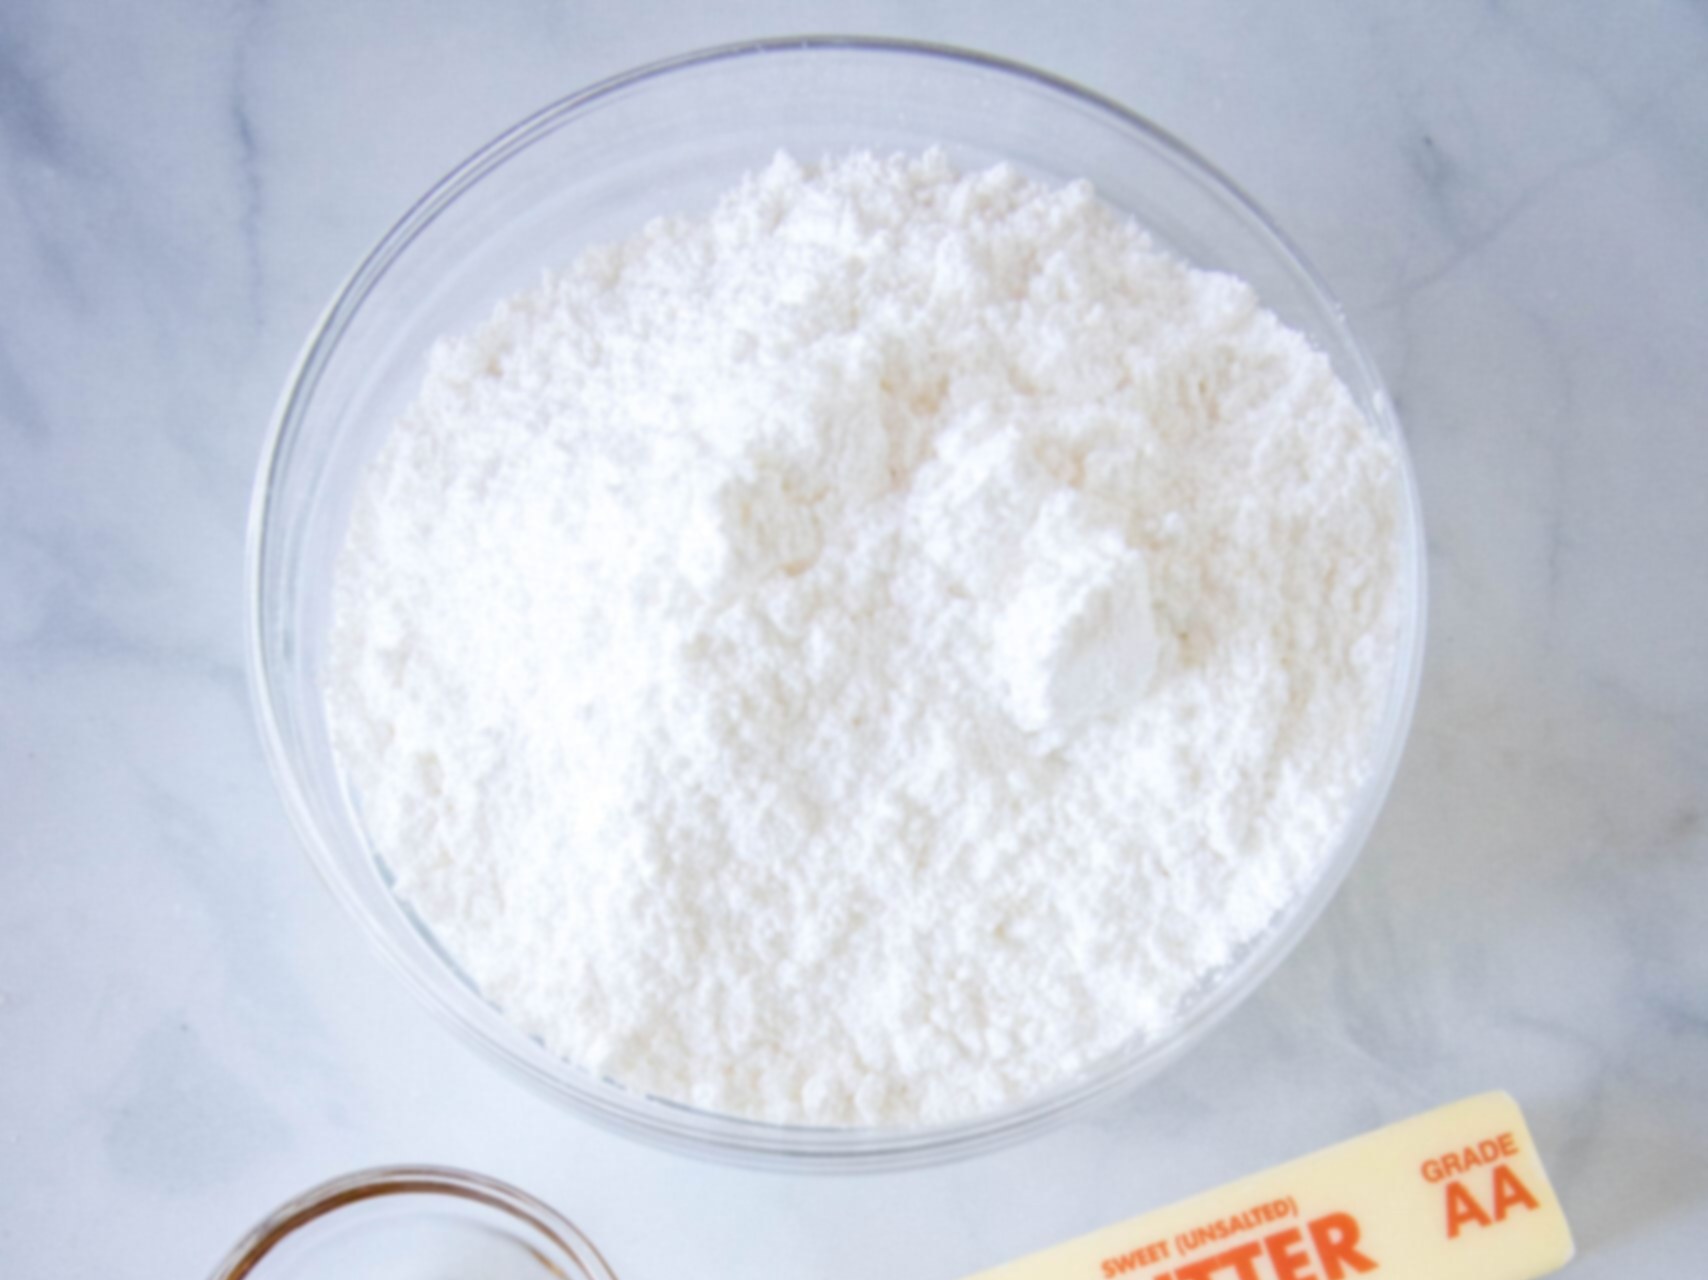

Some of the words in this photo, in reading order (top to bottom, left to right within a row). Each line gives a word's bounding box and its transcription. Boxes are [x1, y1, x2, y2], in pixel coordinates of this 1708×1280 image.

[1419, 1132, 1520, 1187] GRADE
[1100, 1237, 1171, 1280] SWEET
[1175, 1195, 1299, 1257] (UNSALTED)
[1443, 1164, 1540, 1239] AA
